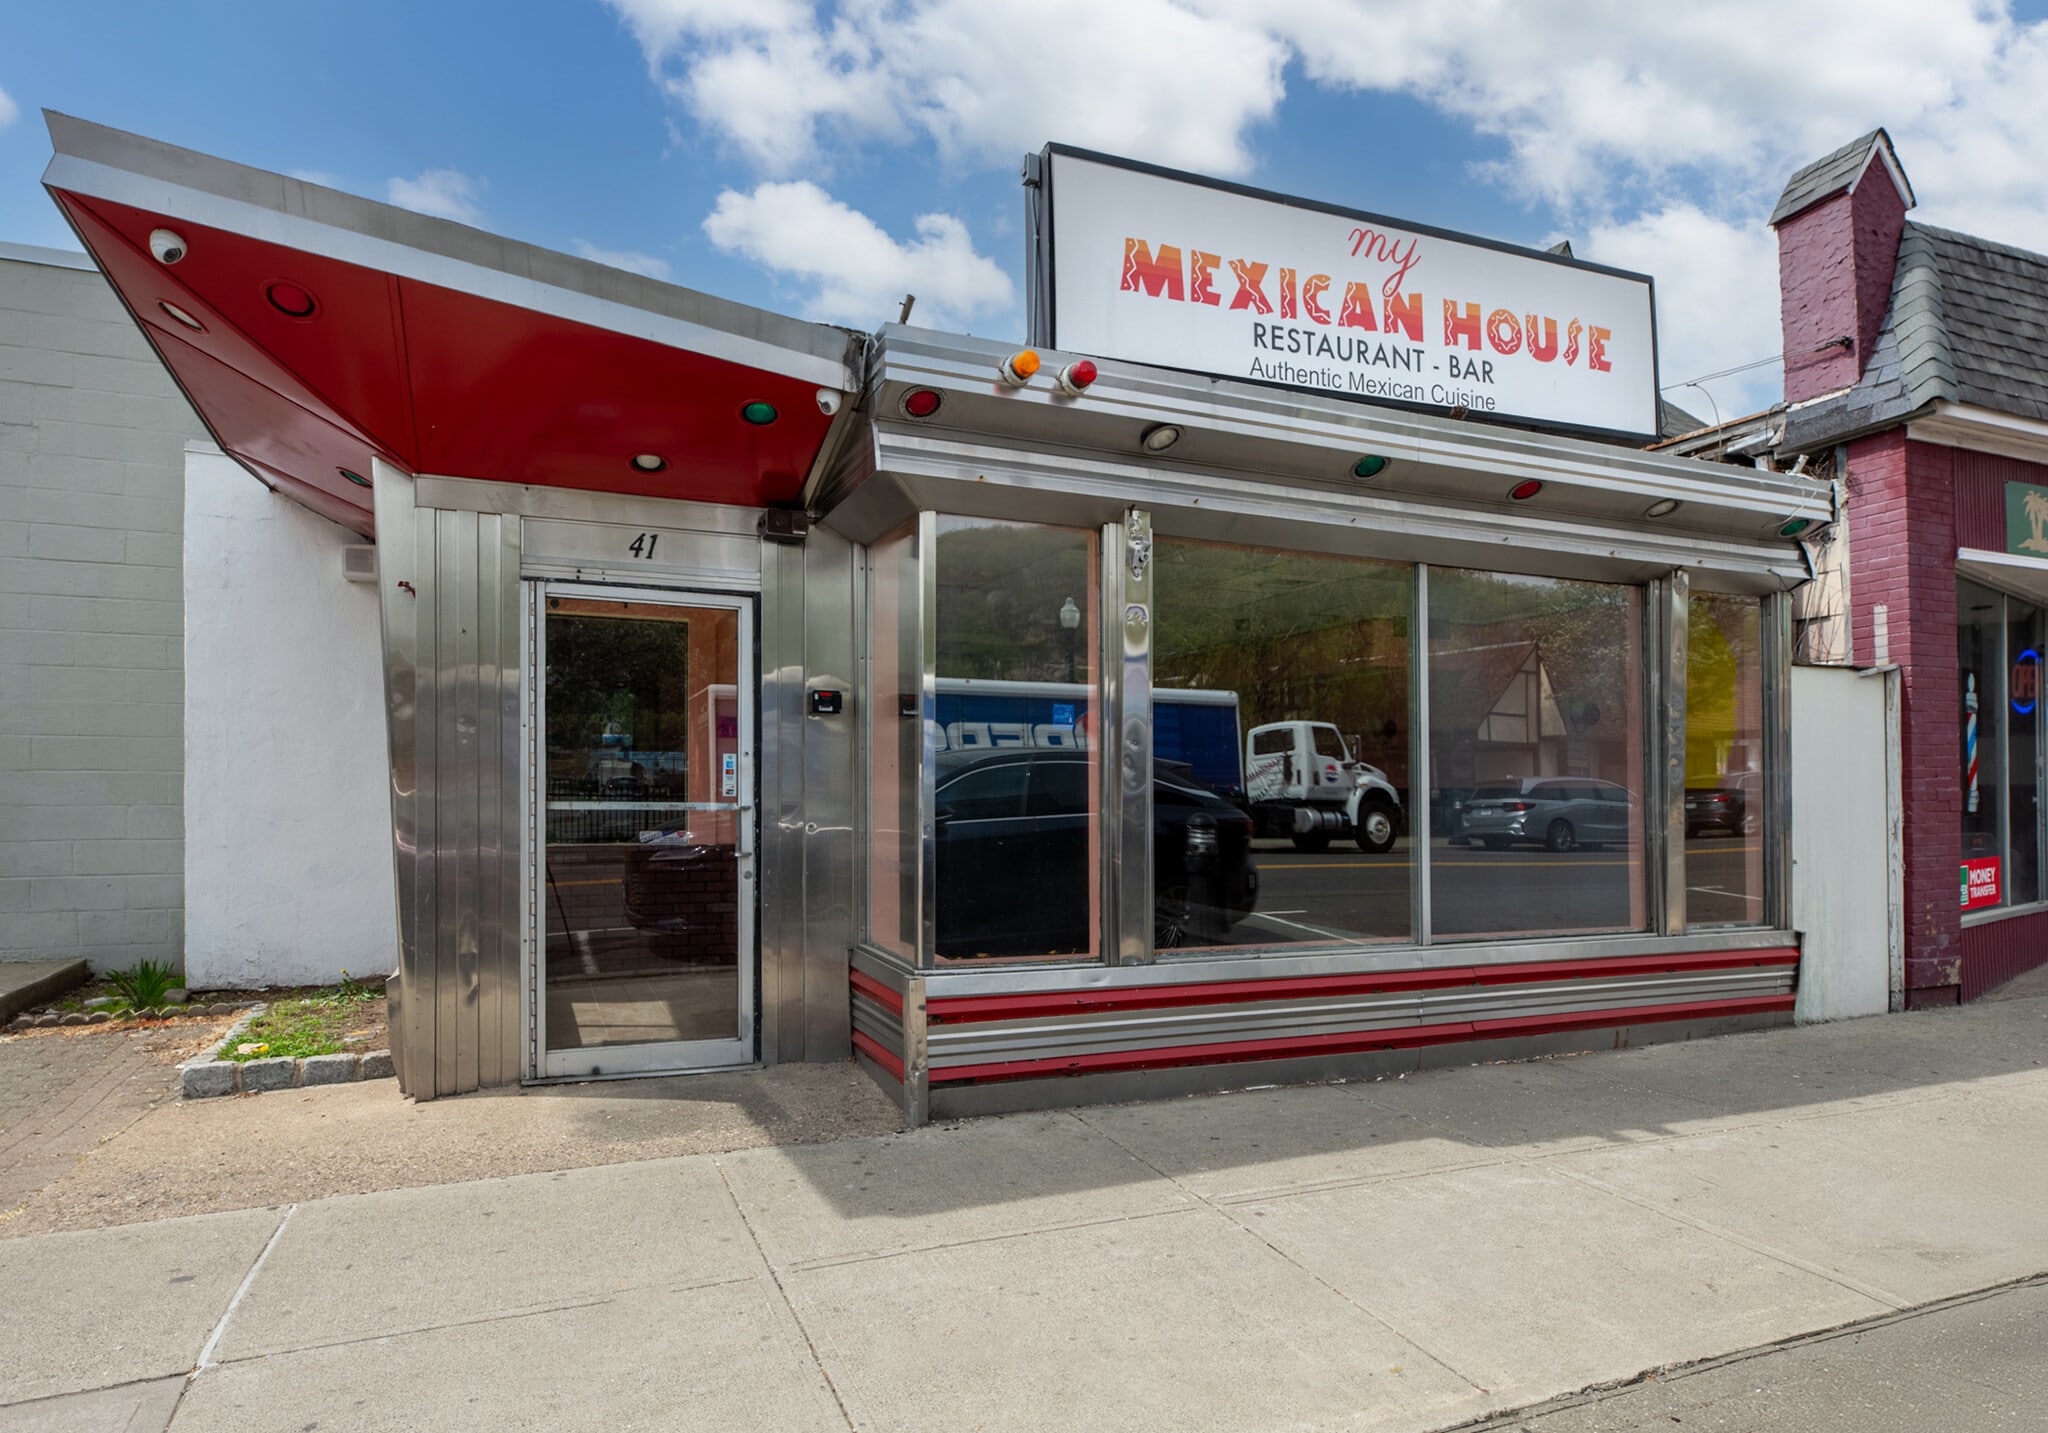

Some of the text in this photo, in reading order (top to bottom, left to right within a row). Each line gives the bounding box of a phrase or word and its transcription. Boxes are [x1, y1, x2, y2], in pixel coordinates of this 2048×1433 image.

[1348, 228, 1422, 298] my
[1119, 236, 1613, 374] MEXICAN HOUSE
[1253, 322, 1425, 373] RESTAURANT
[1449, 354, 1495, 385] BAR
[1249, 356, 1496, 411] Authentic Mexican Cuisine
[628, 532, 659, 560] 41
[2011, 663, 2044, 699] OPE
[1969, 866, 1996, 886] MONEY
[1969, 883, 1997, 899] TRANSFER
